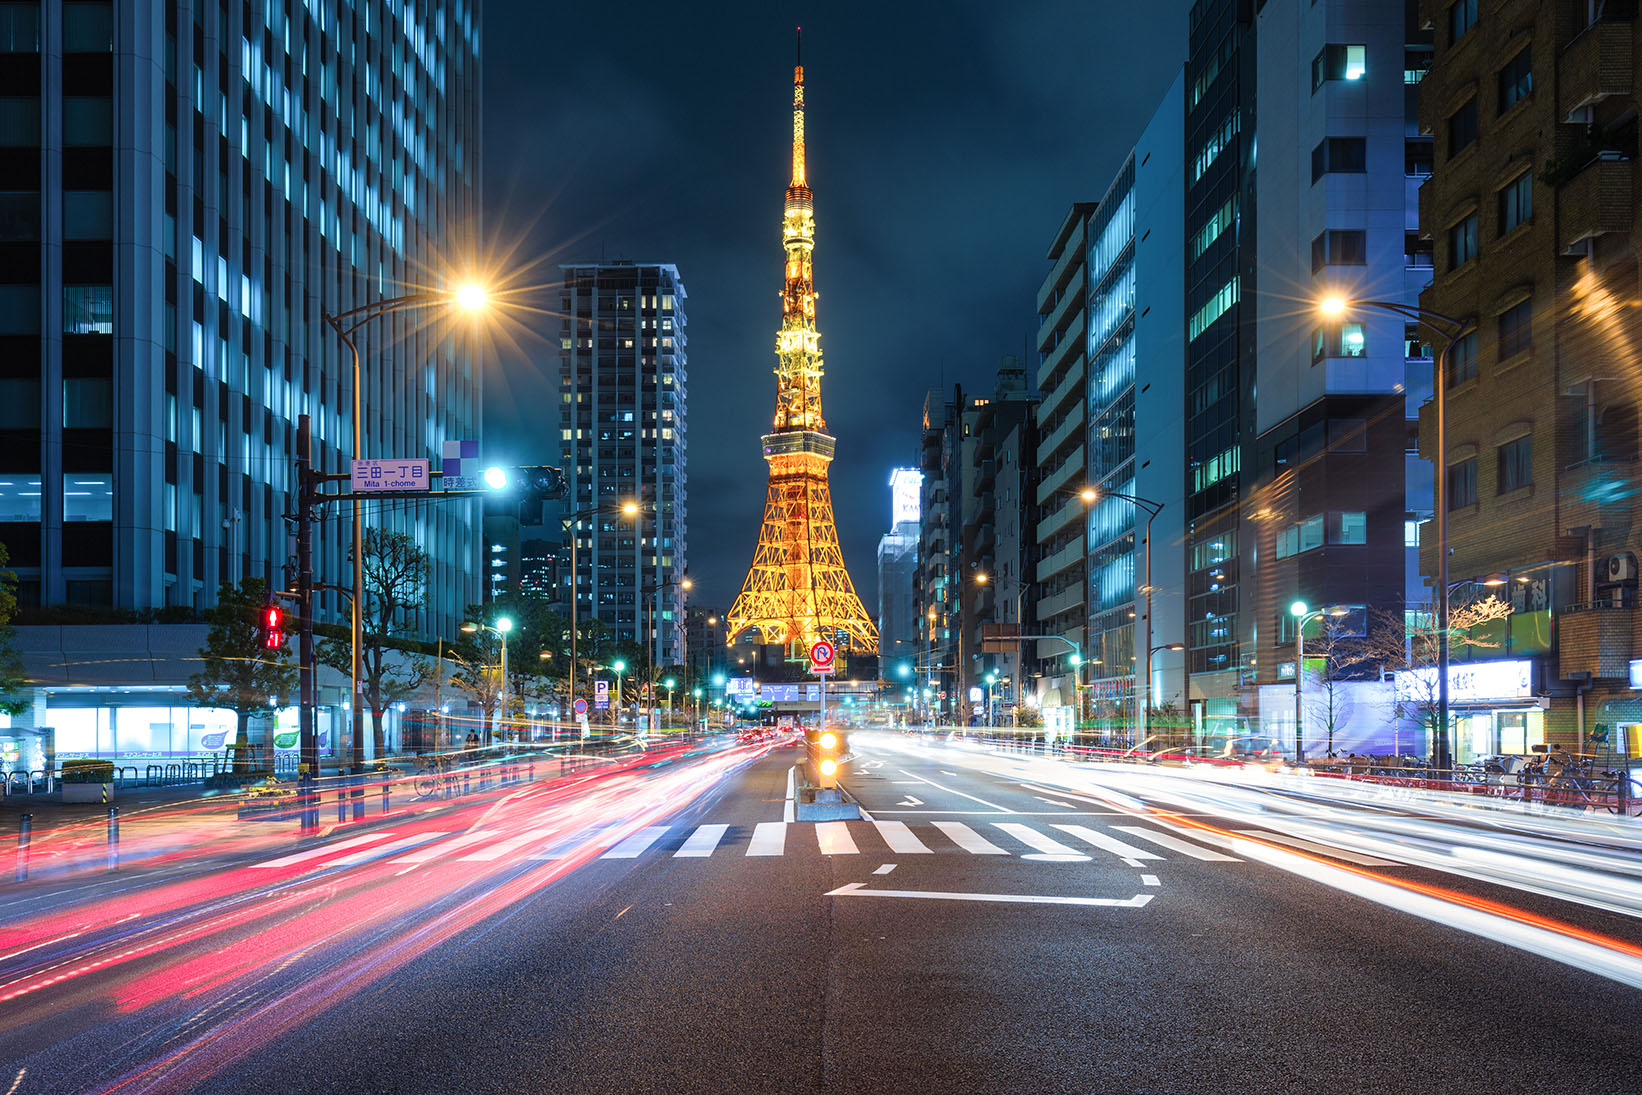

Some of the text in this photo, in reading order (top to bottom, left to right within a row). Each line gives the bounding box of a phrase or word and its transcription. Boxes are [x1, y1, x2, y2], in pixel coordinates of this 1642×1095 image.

[357, 465, 423, 479] 三田一丁目
[364, 480, 380, 488] Mita
[443, 477, 477, 489] 時差式
[597, 682, 606, 694] P
